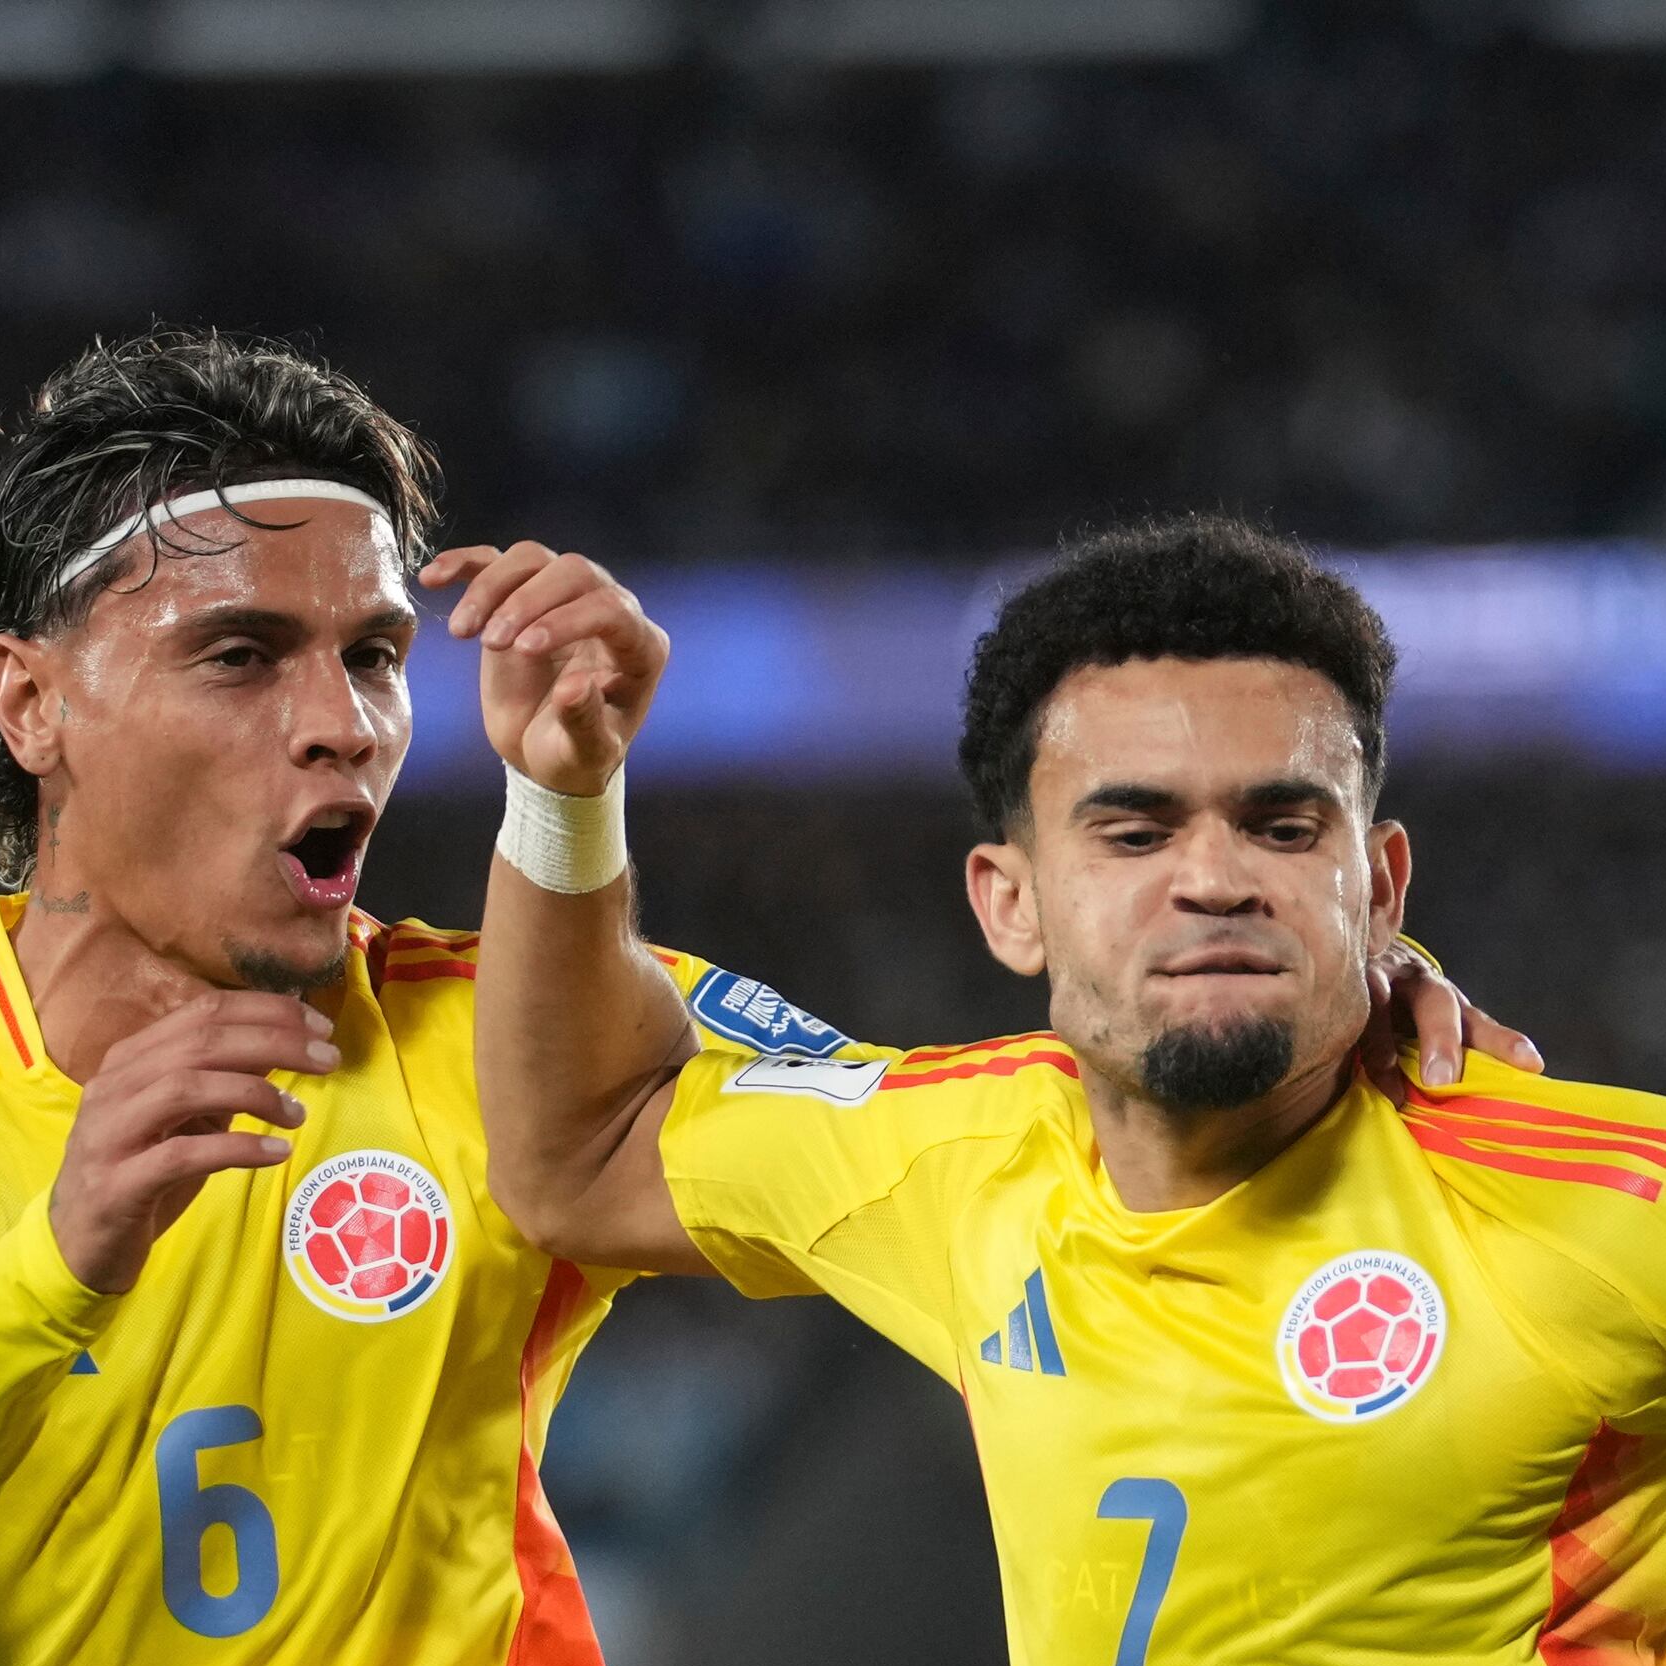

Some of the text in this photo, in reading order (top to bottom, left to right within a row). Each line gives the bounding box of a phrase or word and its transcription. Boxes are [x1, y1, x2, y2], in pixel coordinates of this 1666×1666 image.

[289, 1156, 444, 1251] FEDERACION COLOMBIANA DE FUTBOL
[1285, 1257, 1438, 1339] FEDERACION COLOMBIANA DE FUTBOL
[155, 1403, 280, 1639] 6
